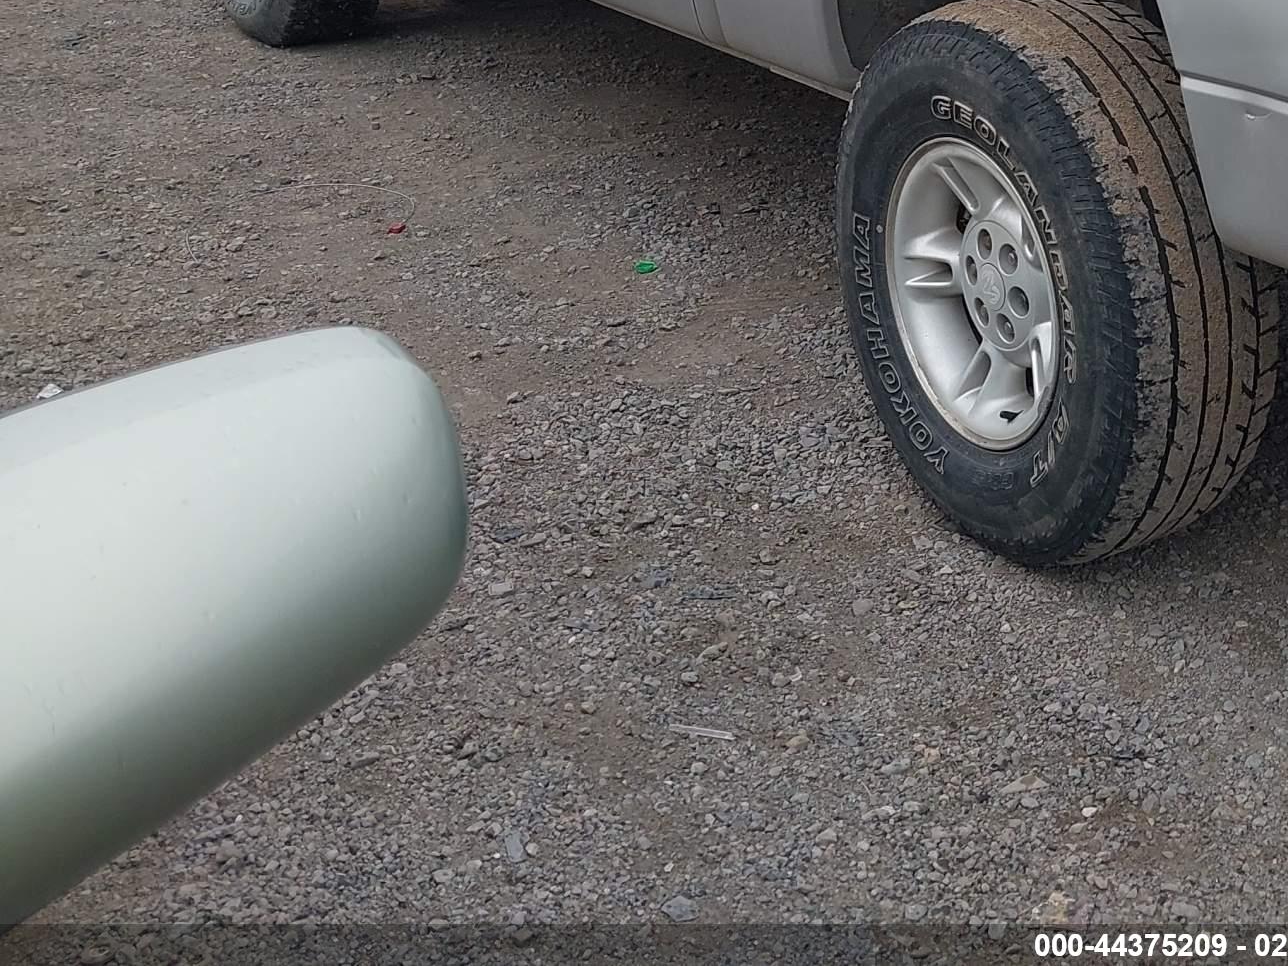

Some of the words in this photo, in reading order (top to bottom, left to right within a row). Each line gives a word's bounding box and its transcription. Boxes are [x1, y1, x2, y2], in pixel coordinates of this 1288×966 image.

[852, 213, 950, 475] YOKOHAMA
[930, 95, 1077, 384] GEOLANDAR
[1030, 397, 1070, 488] A/T
